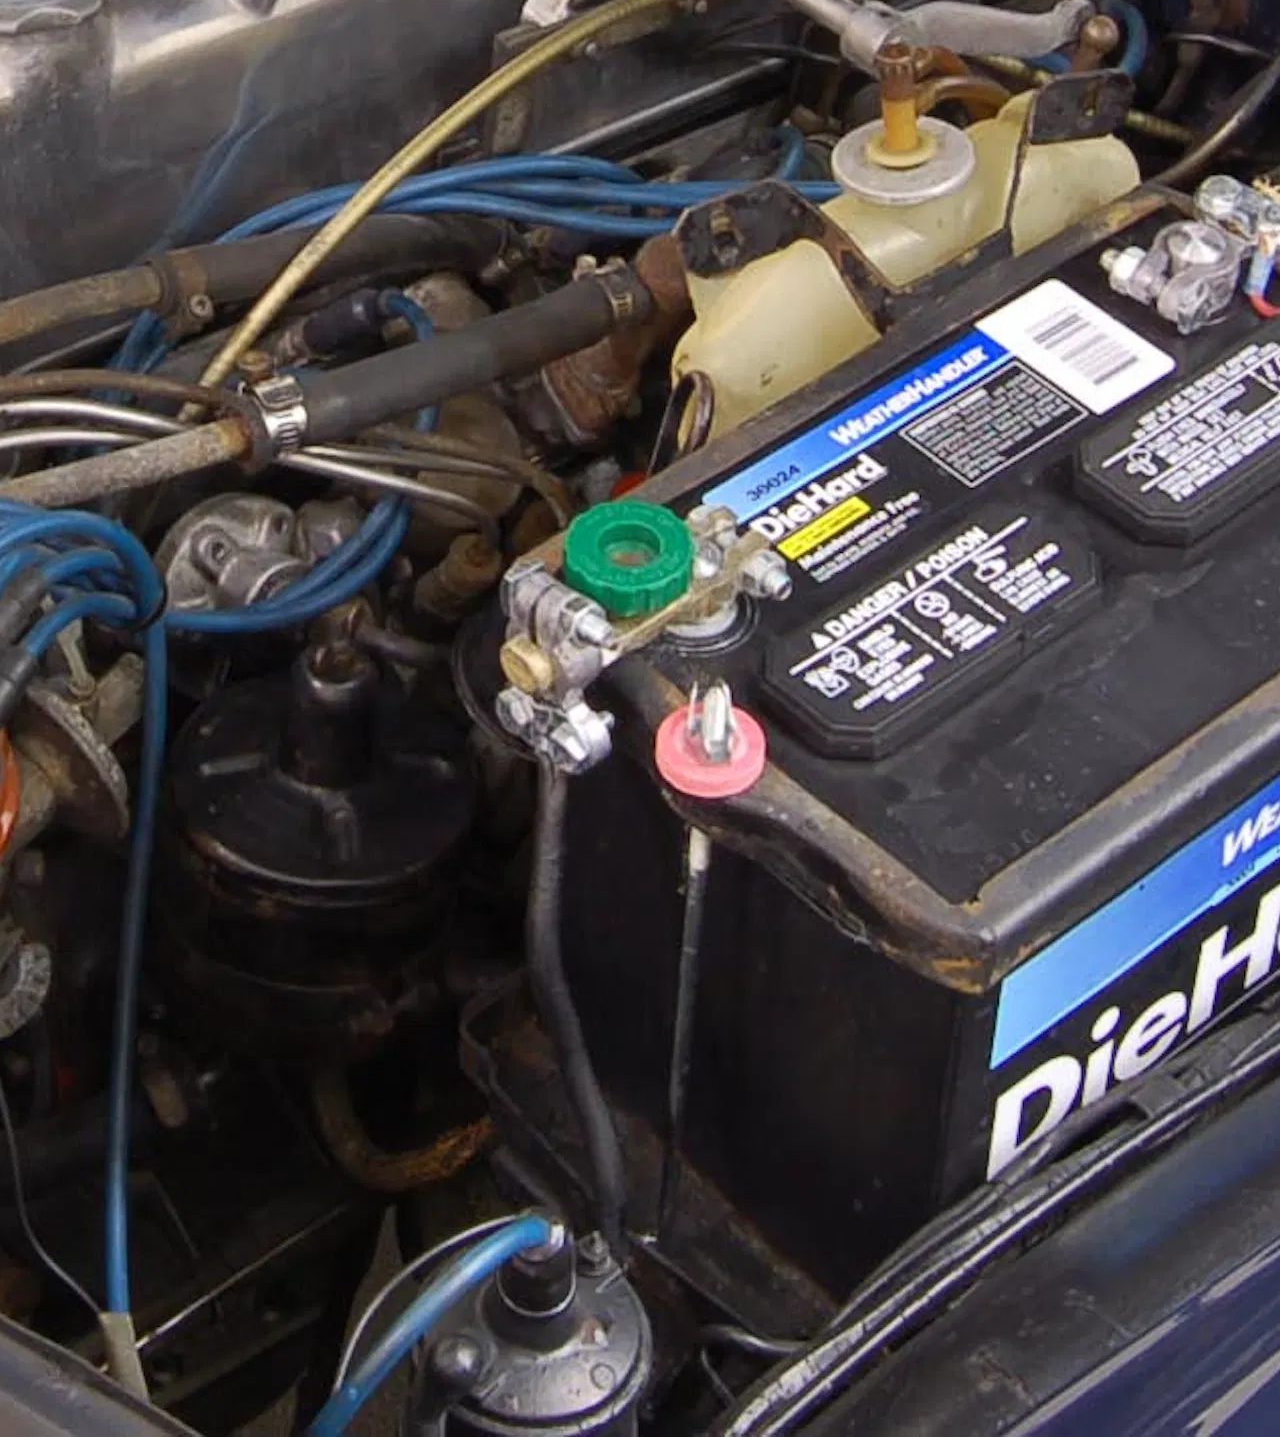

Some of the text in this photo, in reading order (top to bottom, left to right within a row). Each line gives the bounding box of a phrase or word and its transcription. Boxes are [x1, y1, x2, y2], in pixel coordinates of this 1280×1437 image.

[748, 453, 888, 542] DieHard
[823, 580, 910, 639] DANGER
[915, 525, 990, 579] POISON
